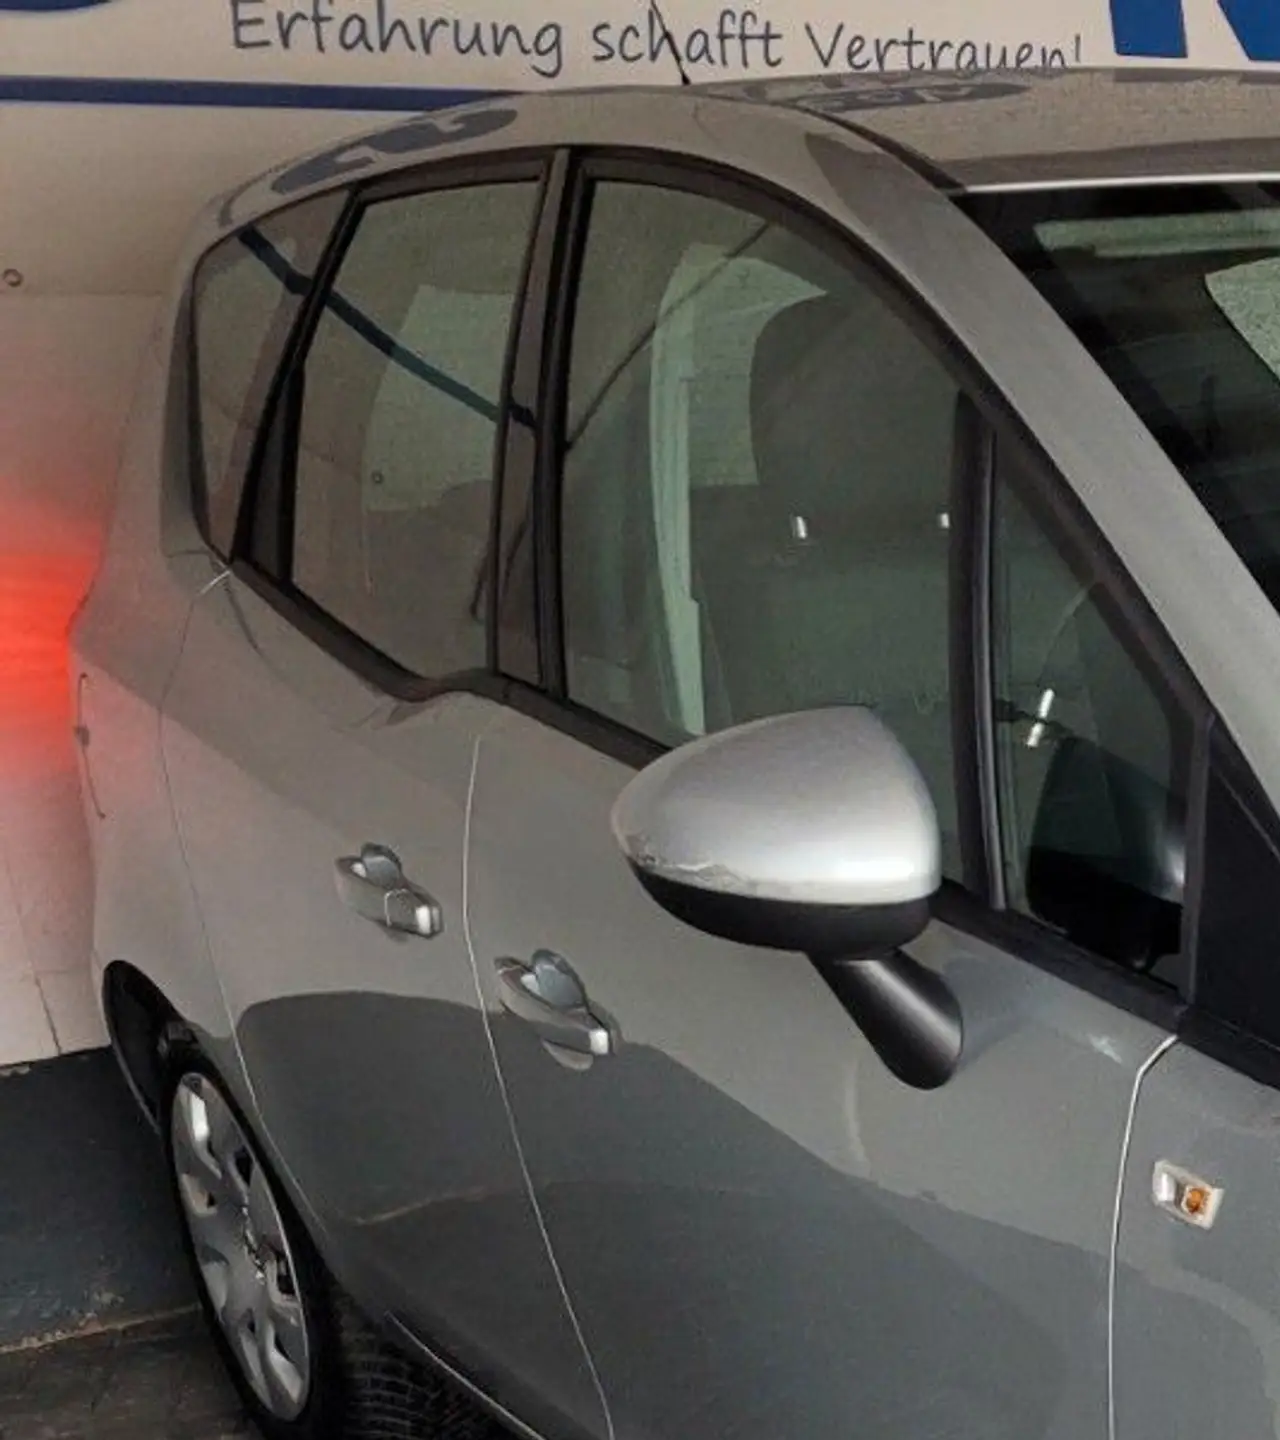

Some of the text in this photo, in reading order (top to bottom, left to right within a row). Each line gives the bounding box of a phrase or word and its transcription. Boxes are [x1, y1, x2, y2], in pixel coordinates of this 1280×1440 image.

[231, 0, 563, 77] Erfahrung
[592, 8, 782, 68] schafft
[804, 22, 1081, 71] Vertrauen!
